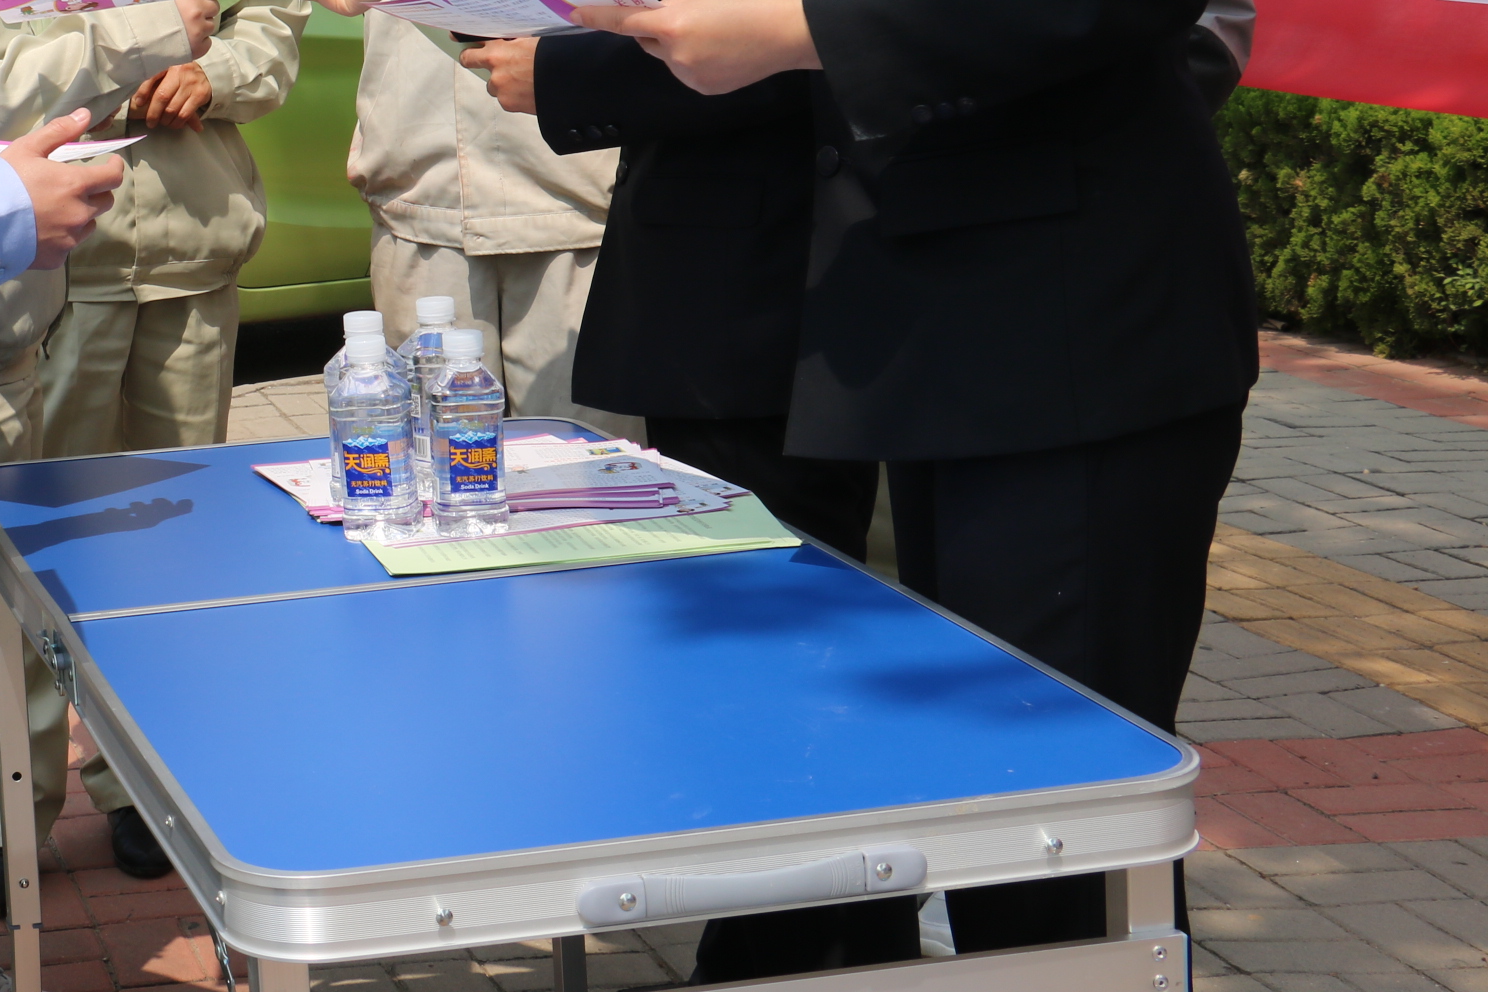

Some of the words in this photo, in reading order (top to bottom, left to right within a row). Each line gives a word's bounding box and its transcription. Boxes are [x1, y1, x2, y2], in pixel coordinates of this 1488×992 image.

[343, 450, 391, 476] 天润斋
[450, 445, 497, 471] 天润斋
